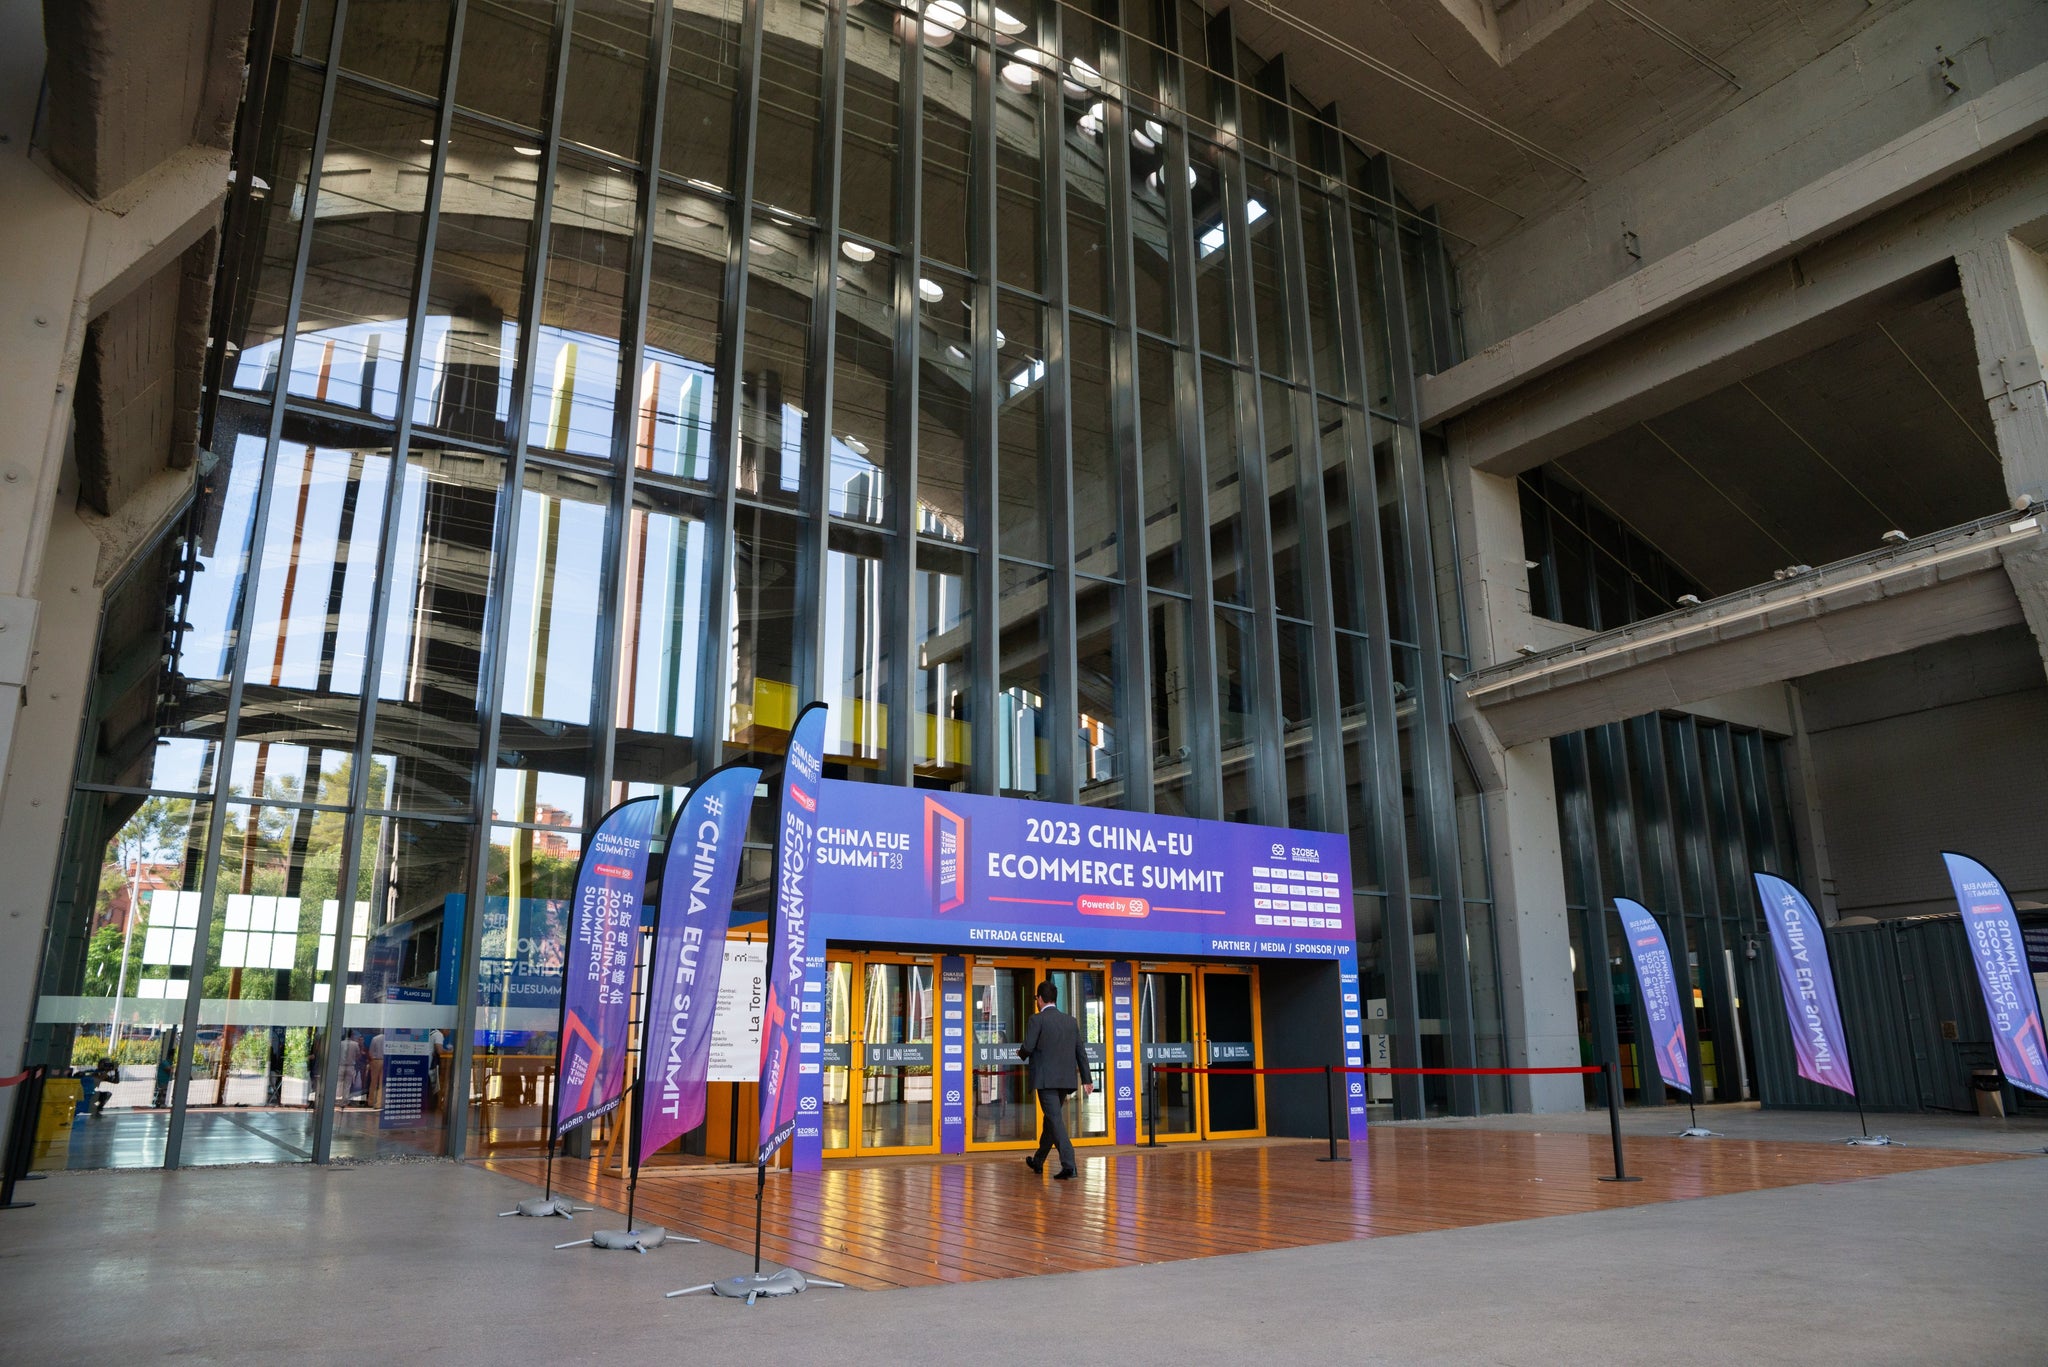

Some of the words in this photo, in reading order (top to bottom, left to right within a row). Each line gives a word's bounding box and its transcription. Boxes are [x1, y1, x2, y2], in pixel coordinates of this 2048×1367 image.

[941, 847, 956, 855] NEW
[1026, 818, 1081, 846] 2023
[1088, 825, 1193, 856] CHINA-EU
[780, 811, 797, 920] SUMMIT
[941, 865, 956, 873] 2023
[988, 852, 1135, 887] ECOMMERCE
[1142, 865, 1224, 893] SUMMIT
[579, 886, 596, 944] SUMMIT
[607, 890, 621, 926] 2023
[1081, 899, 1115, 910] Powered
[1116, 901, 1126, 912] by
[588, 887, 609, 981] ECOMMERCE
[970, 928, 1018, 941] ENTRADA
[1019, 932, 1065, 944] GENERAL
[1212, 940, 1251, 951] PARTNER
[1260, 942, 1286, 952] MEDIA
[1295, 943, 1332, 954] SPONSOR
[1338, 945, 1350, 955] VIP
[599, 931, 617, 1004] CHINA-EU
[676, 926, 704, 987] EUE
[749, 977, 761, 1011] Torre
[749, 1016, 760, 1032] La
[661, 993, 691, 1119] SUMMIT
[567, 1075, 585, 1086] NEW
[559, 1115, 583, 1133] MADRID
